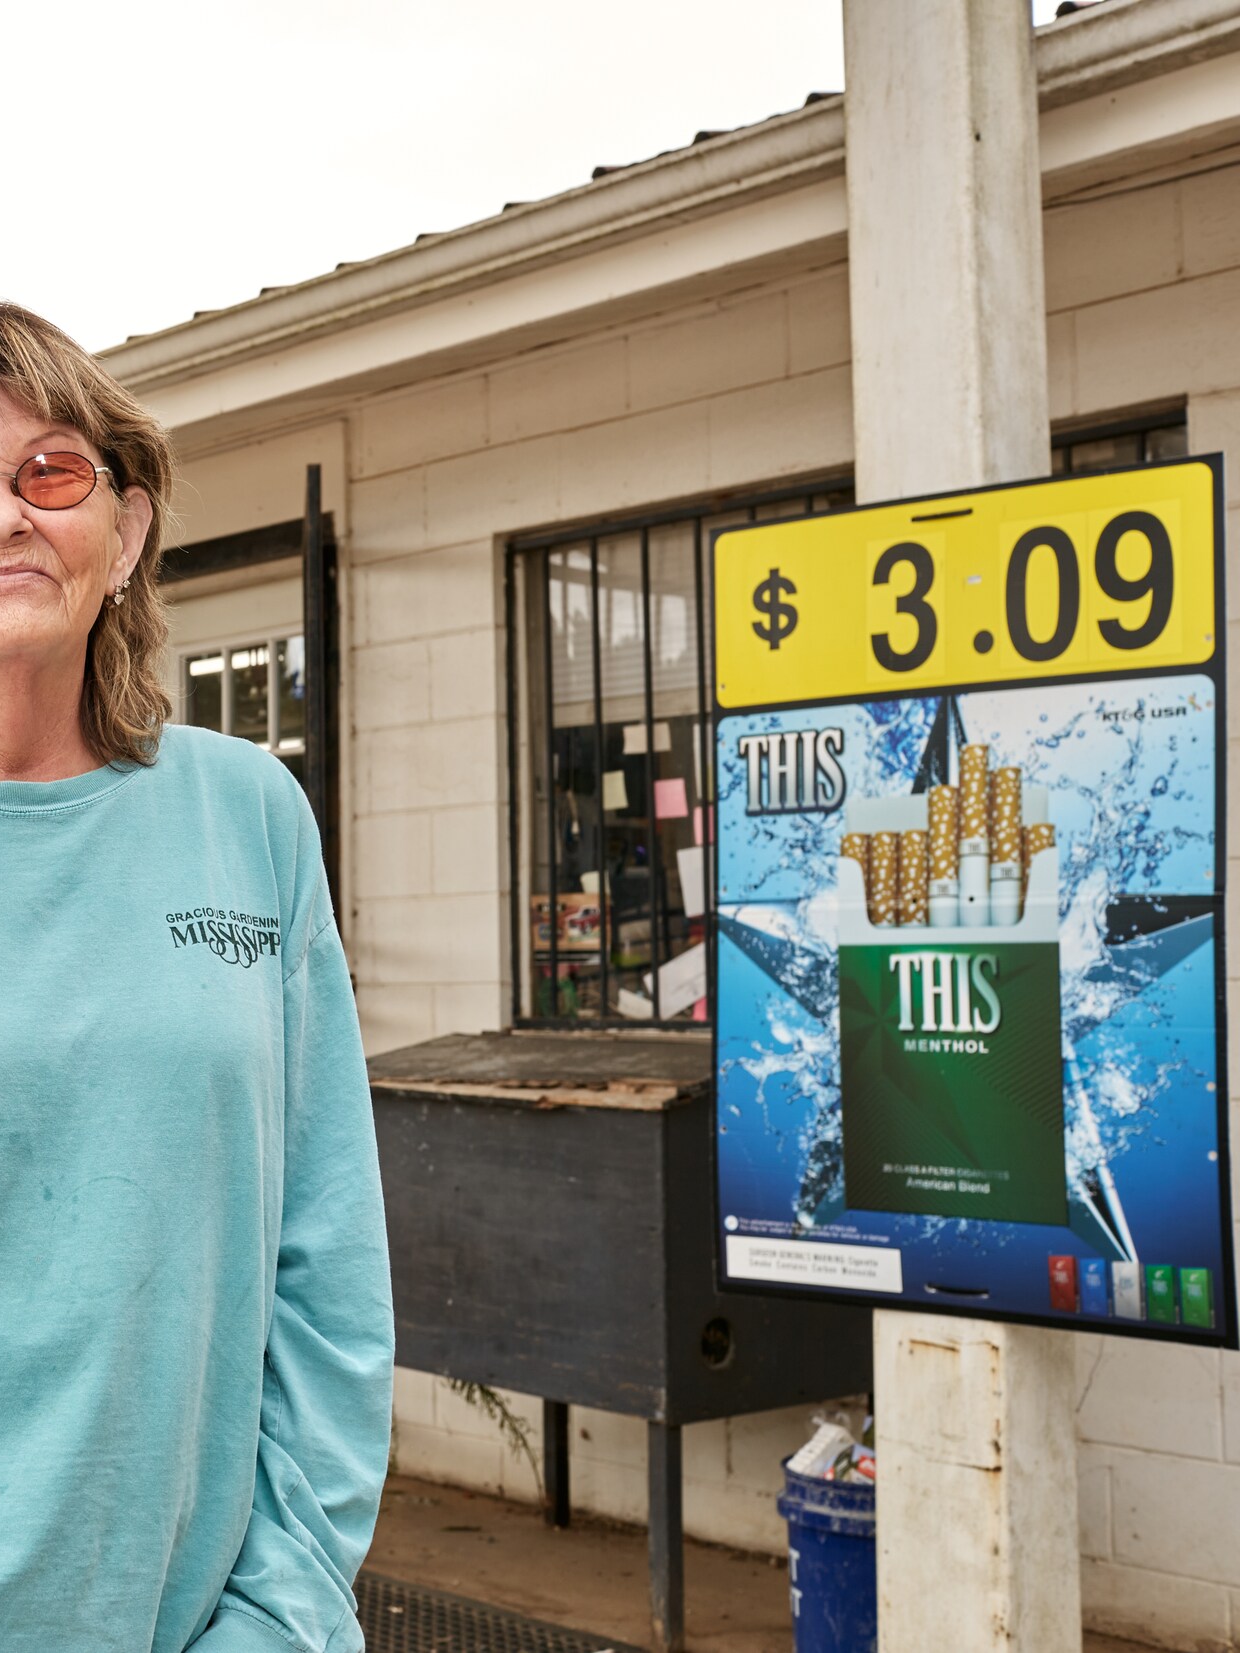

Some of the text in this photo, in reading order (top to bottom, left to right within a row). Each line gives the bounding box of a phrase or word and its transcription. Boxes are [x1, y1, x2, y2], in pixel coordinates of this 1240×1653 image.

[752, 511, 1174, 672] $ 3.09
[1151, 706, 1187, 719] USA
[738, 727, 847, 817] THIS
[165, 907, 279, 928] GRACIOUS GARDENIN
[168, 919, 281, 969] MISSISSIPP
[889, 953, 1001, 1033] THIS
[904, 1039, 989, 1054] MENTHOL
